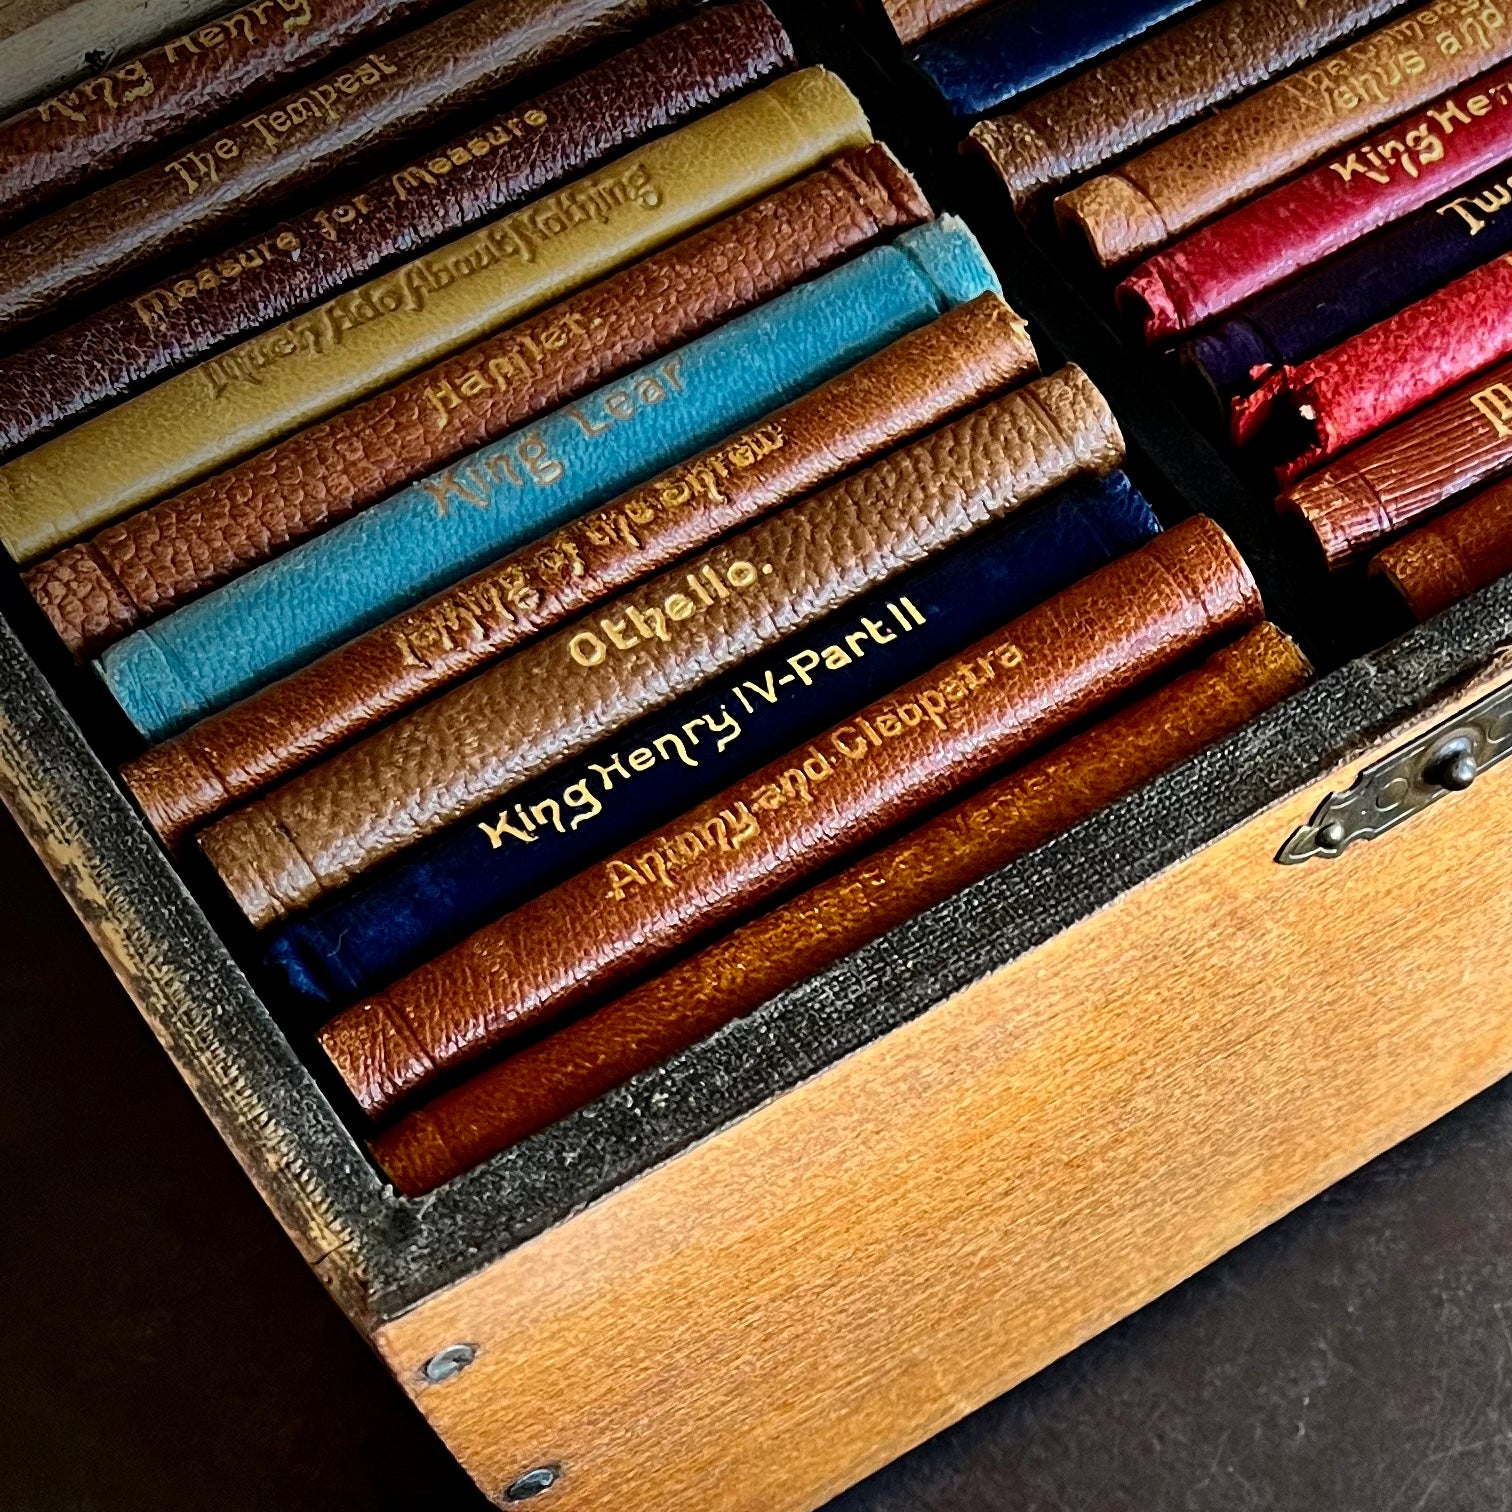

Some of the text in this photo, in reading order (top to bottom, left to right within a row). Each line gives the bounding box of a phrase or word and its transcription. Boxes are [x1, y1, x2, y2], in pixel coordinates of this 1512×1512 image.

[165, 53, 398, 195] The Tempest
[1300, 49, 1426, 116] Venus
[1435, 7, 1504, 55] and
[133, 107, 548, 329] Measure for Measure
[1329, 123, 1444, 184] King
[200, 163, 664, 400] Much Ado About Nothing
[424, 358, 684, 518] King Lear
[568, 560, 774, 667] Othello.
[478, 596, 927, 850] King Henry IV-Part II
[605, 801, 760, 900] Antony
[831, 641, 1025, 760] Cleopatra
